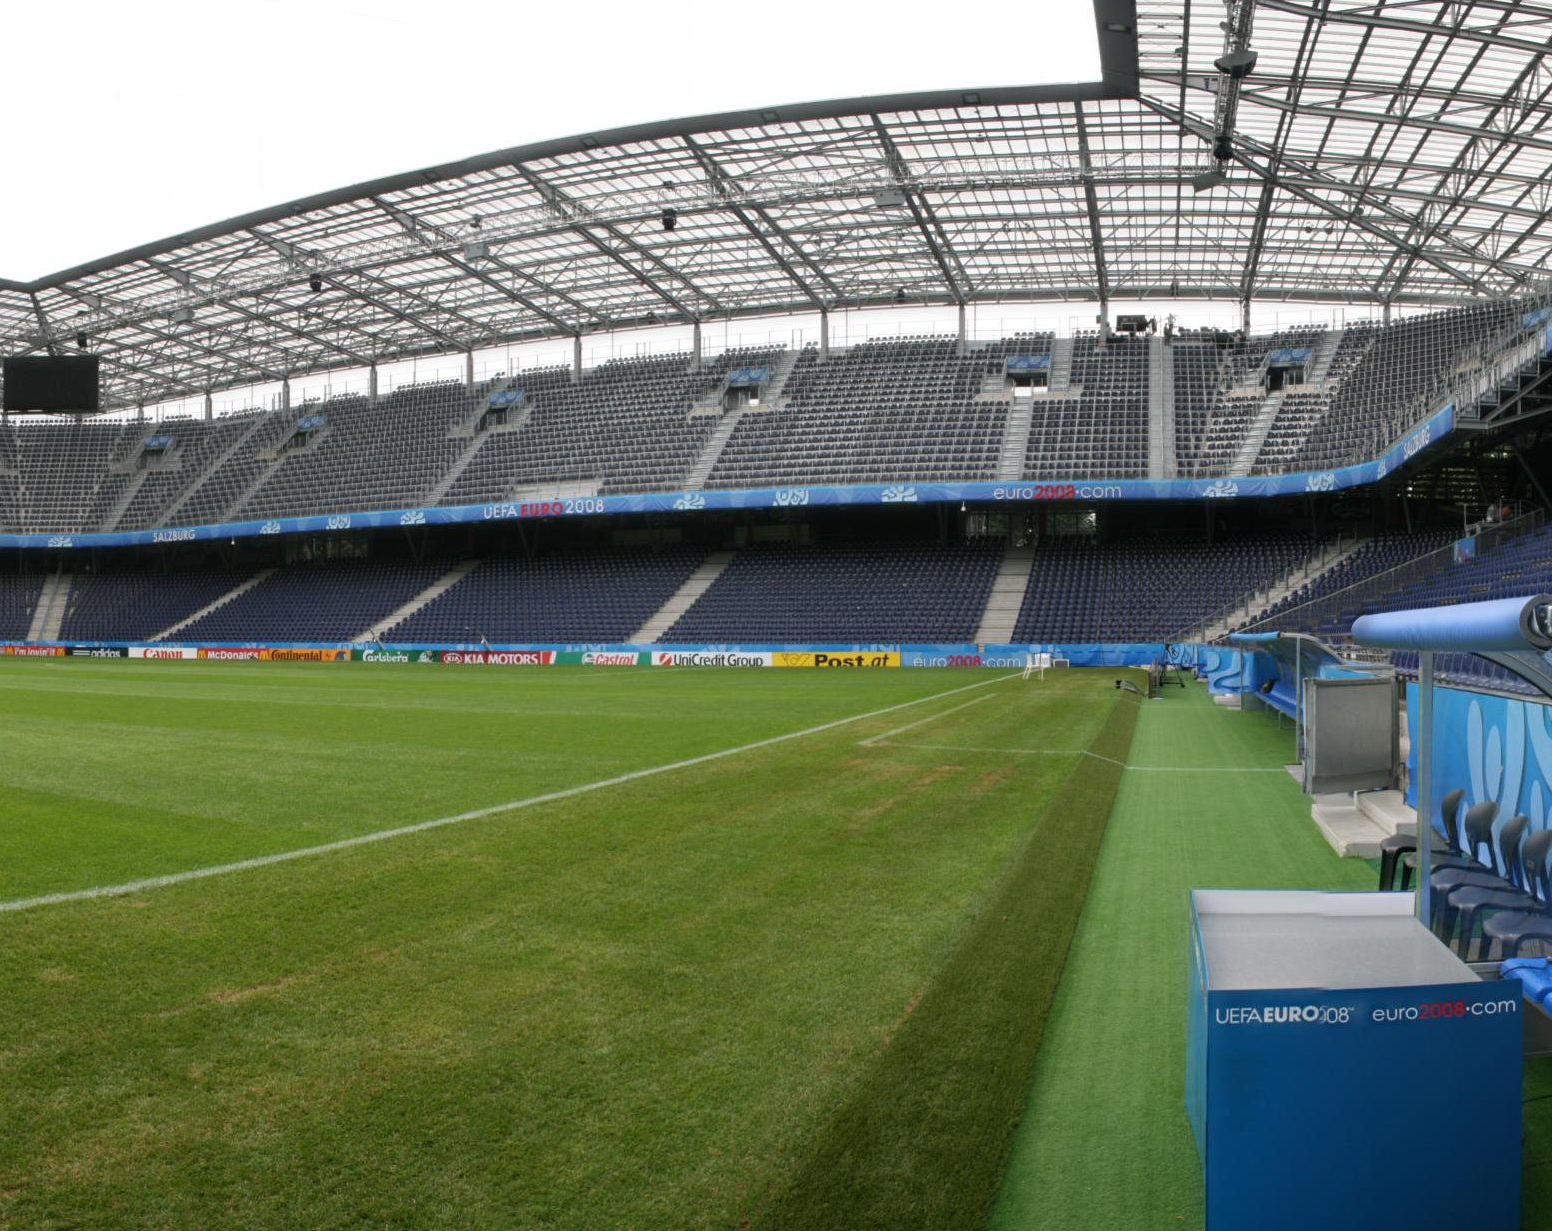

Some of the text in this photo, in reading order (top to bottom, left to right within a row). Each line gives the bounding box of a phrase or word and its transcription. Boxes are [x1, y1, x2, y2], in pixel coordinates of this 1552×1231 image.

[483, 499, 605, 519] UEFA EURO 2008
[153, 529, 196, 543] SALZBURG
[91, 648, 121, 658] adidas
[143, 648, 183, 659] Canon
[207, 650, 259, 660] McDonald's
[270, 649, 323, 660] Continental
[362, 649, 409, 662] Carlsberg
[464, 654, 485, 664] KIA
[487, 654, 539, 665] MOTORS
[594, 653, 635, 666] Castrol
[673, 653, 764, 667] UniCredit Group
